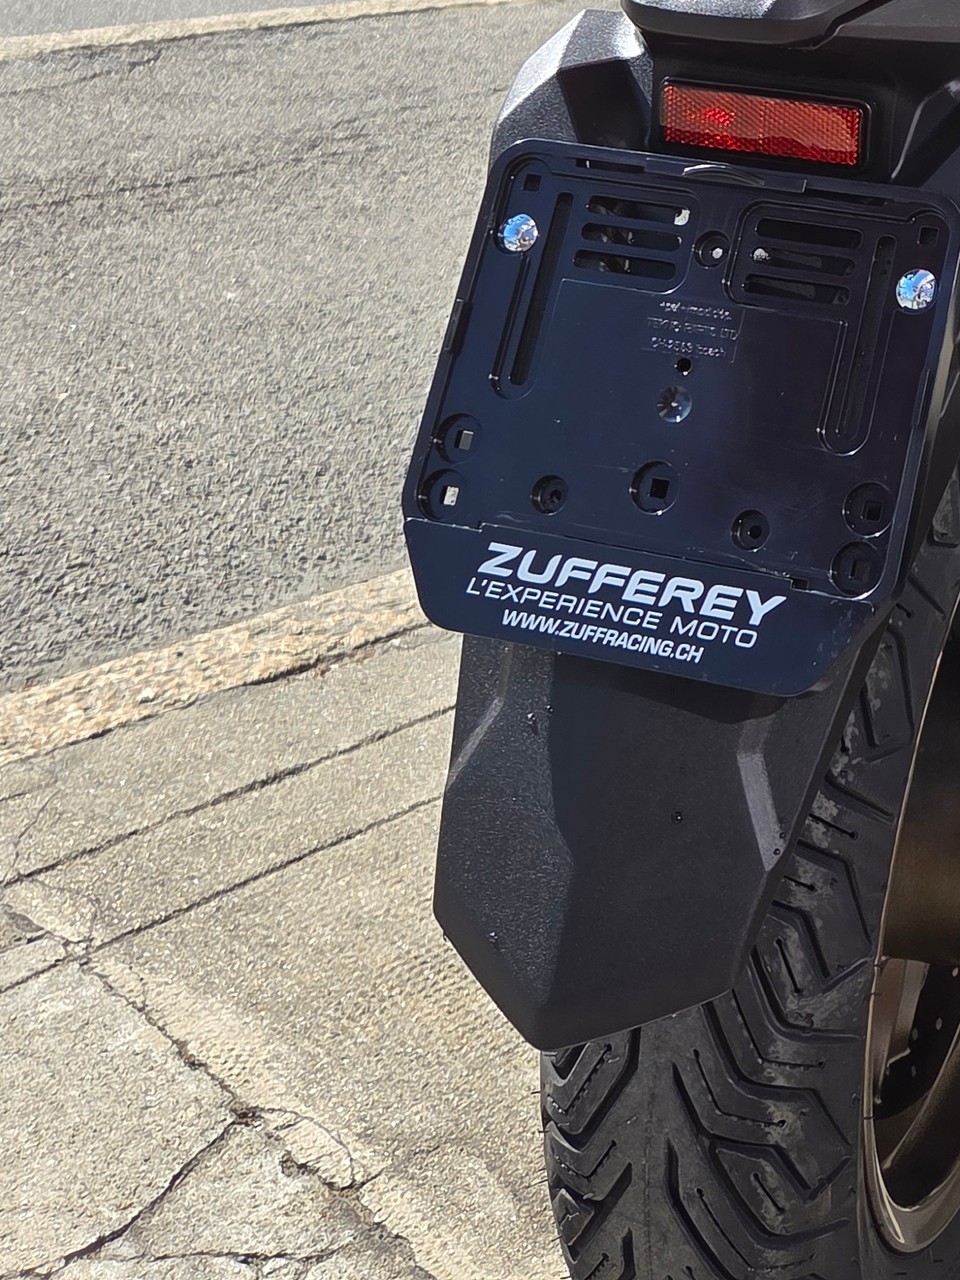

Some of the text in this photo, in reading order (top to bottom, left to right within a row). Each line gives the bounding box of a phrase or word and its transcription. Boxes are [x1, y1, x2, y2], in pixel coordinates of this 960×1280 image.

[465, 577, 758, 649] L'EXPERIENCE MOTO
[477, 541, 787, 627] ZUFFEREY
[501, 608, 705, 664] WWW.ZUFFRACING.CH
